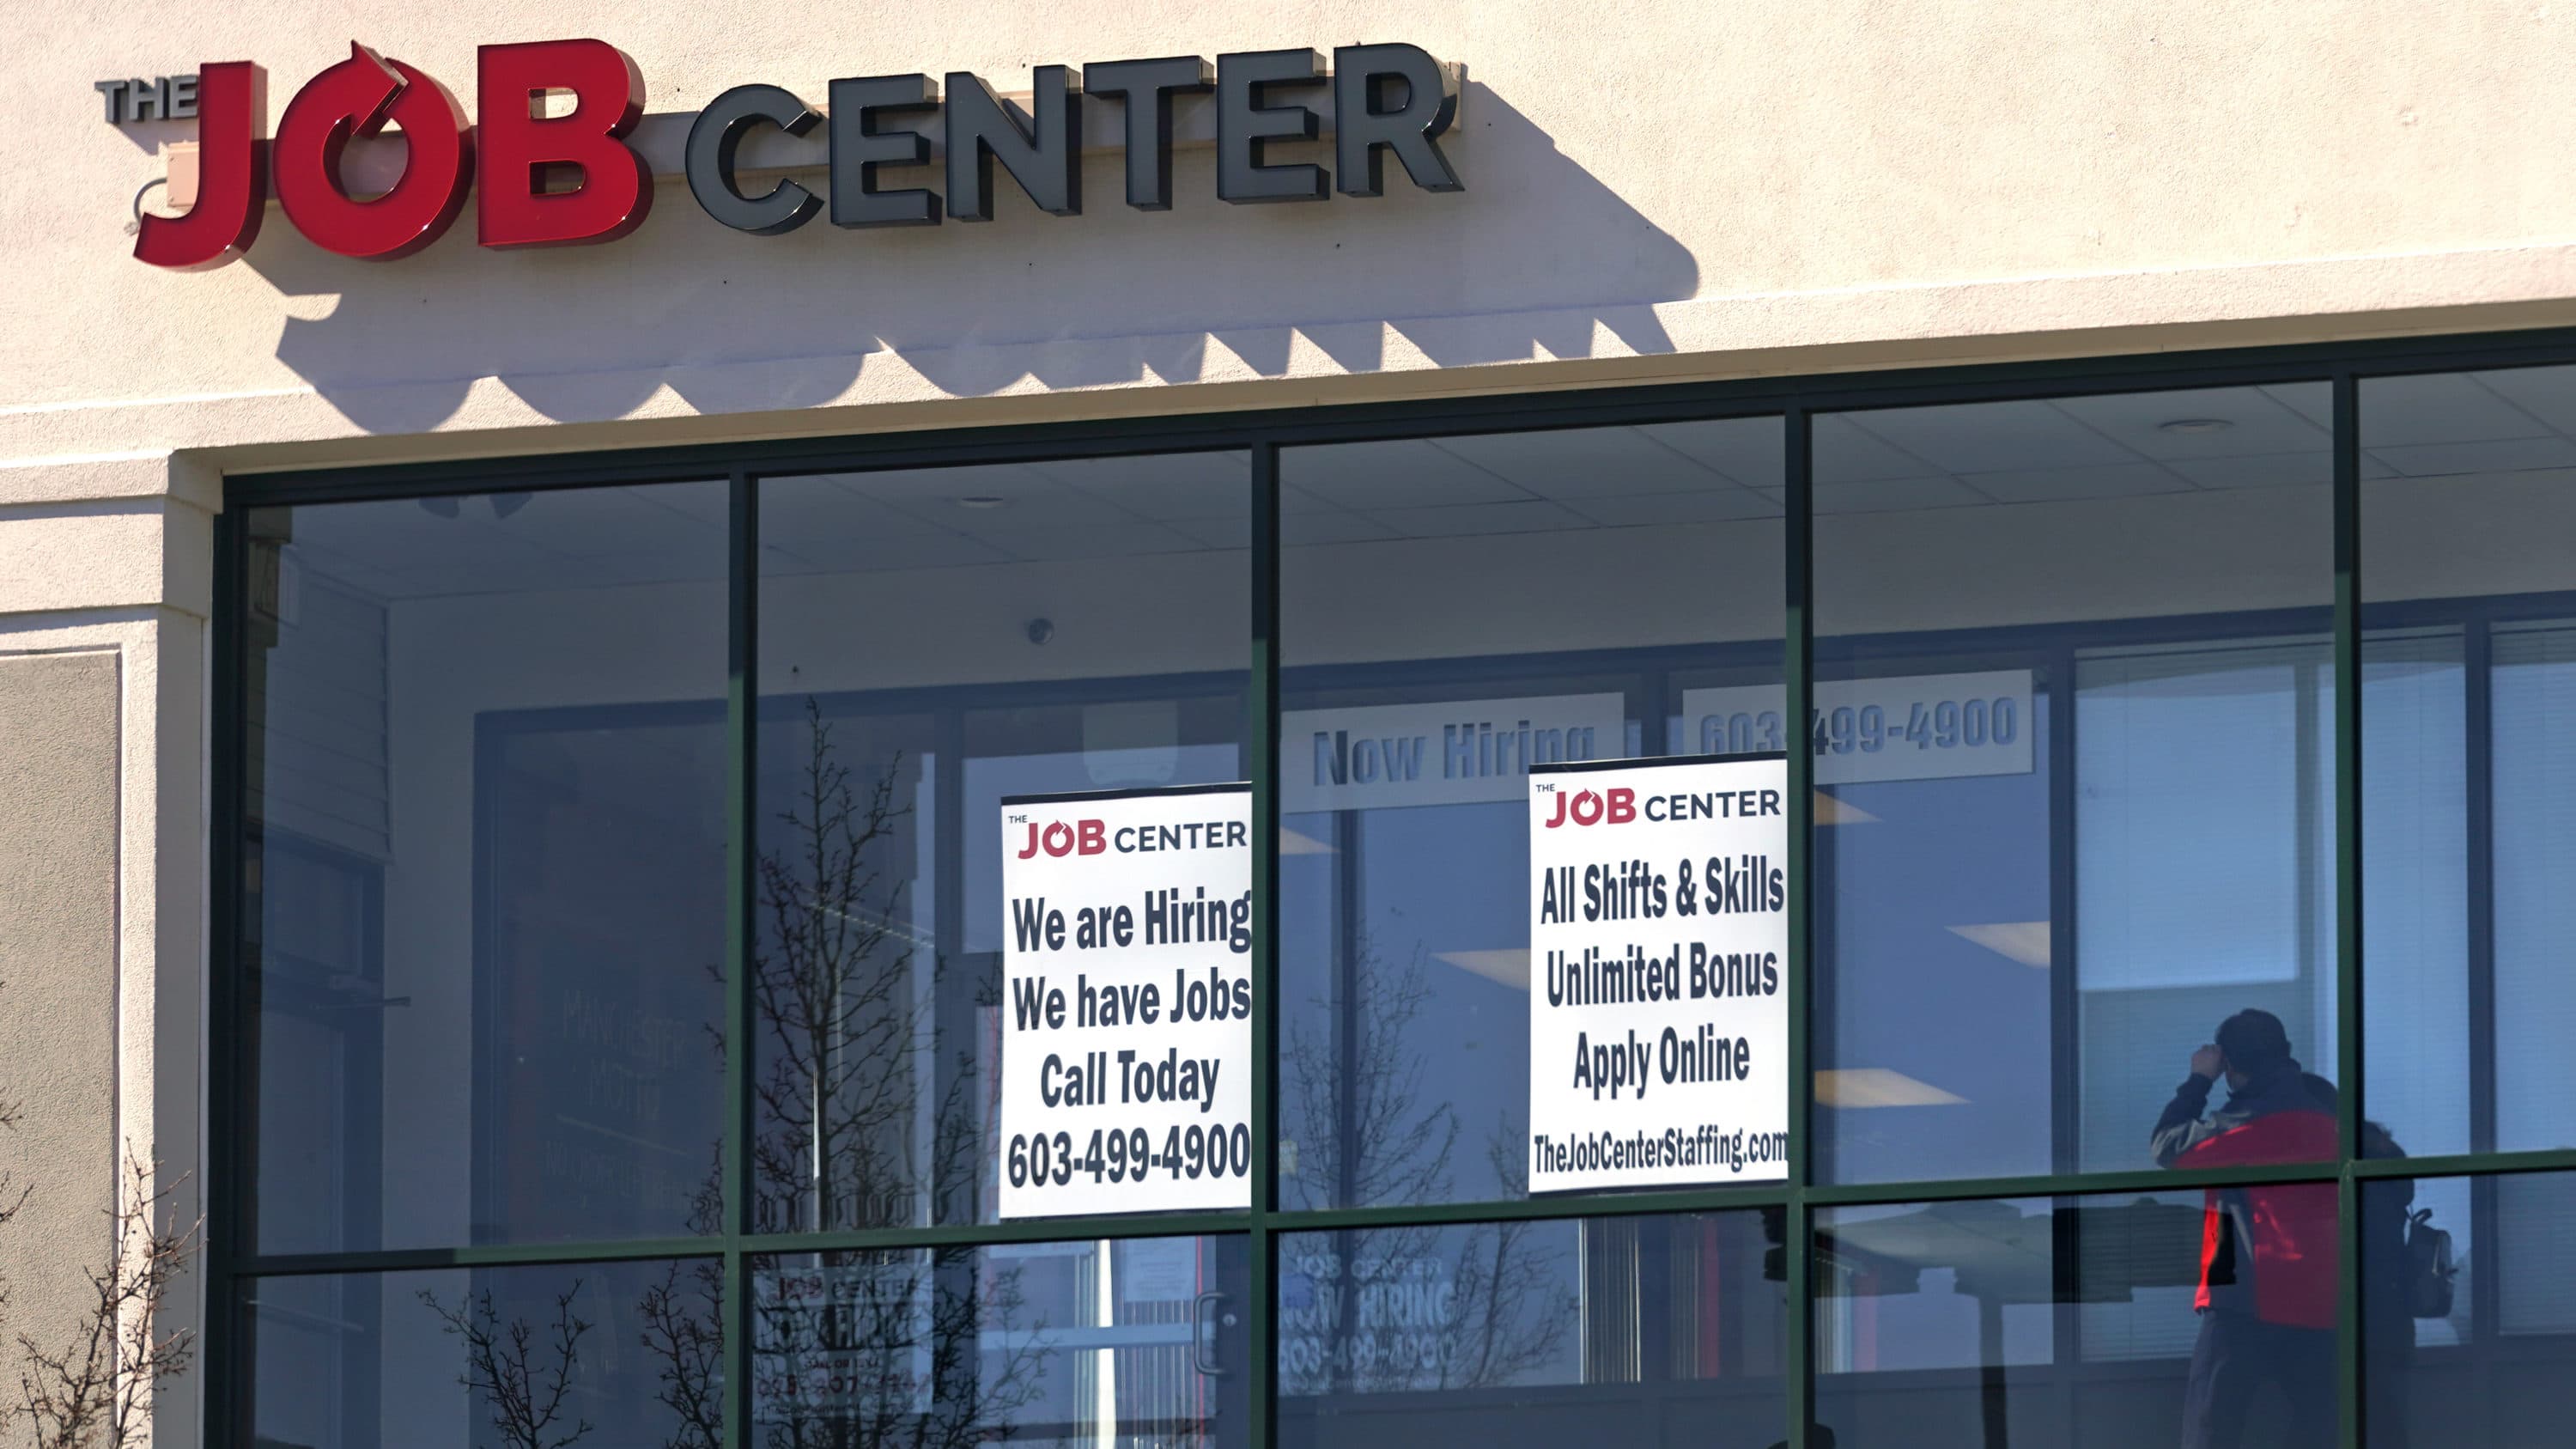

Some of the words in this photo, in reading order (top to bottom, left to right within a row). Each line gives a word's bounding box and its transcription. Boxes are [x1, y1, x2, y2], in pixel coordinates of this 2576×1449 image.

[94, 75, 200, 124] THE
[133, 39, 654, 271] JOB
[684, 42, 1465, 236] CENTER
[1313, 729, 1426, 787] Now
[1008, 814, 1029, 825] THE
[1115, 820, 1247, 855] CENTER
[1535, 782, 1556, 793] THE
[1546, 787, 1637, 829] JOB
[1644, 789, 1781, 822] CENTER
[1018, 819, 1107, 860] JOB
[1012, 897, 1066, 953] We
[1076, 905, 1134, 950] are
[1145, 886, 1252, 954] Hiring
[1540, 866, 1576, 925] All
[1583, 859, 1668, 922] Shifts
[1675, 859, 1698, 917] &
[1704, 855, 1785, 917] Skills
[1012, 976, 1066, 1032] We
[1078, 973, 1160, 1028] have
[1170, 966, 1252, 1024] Jobs
[1547, 943, 1680, 1008] Unlimited
[1690, 941, 1778, 1000] Bonus
[1041, 1051, 1107, 1109] Call
[1117, 1047, 1220, 1114] Today
[1572, 1029, 1652, 1102] Apply
[1659, 1022, 1750, 1087] Online
[1007, 1122, 1252, 1190] 603-499-4900
[1534, 1126, 1788, 1174] TheJobCenterStaffing.com
[1358, 1281, 1456, 1328] HIRING
